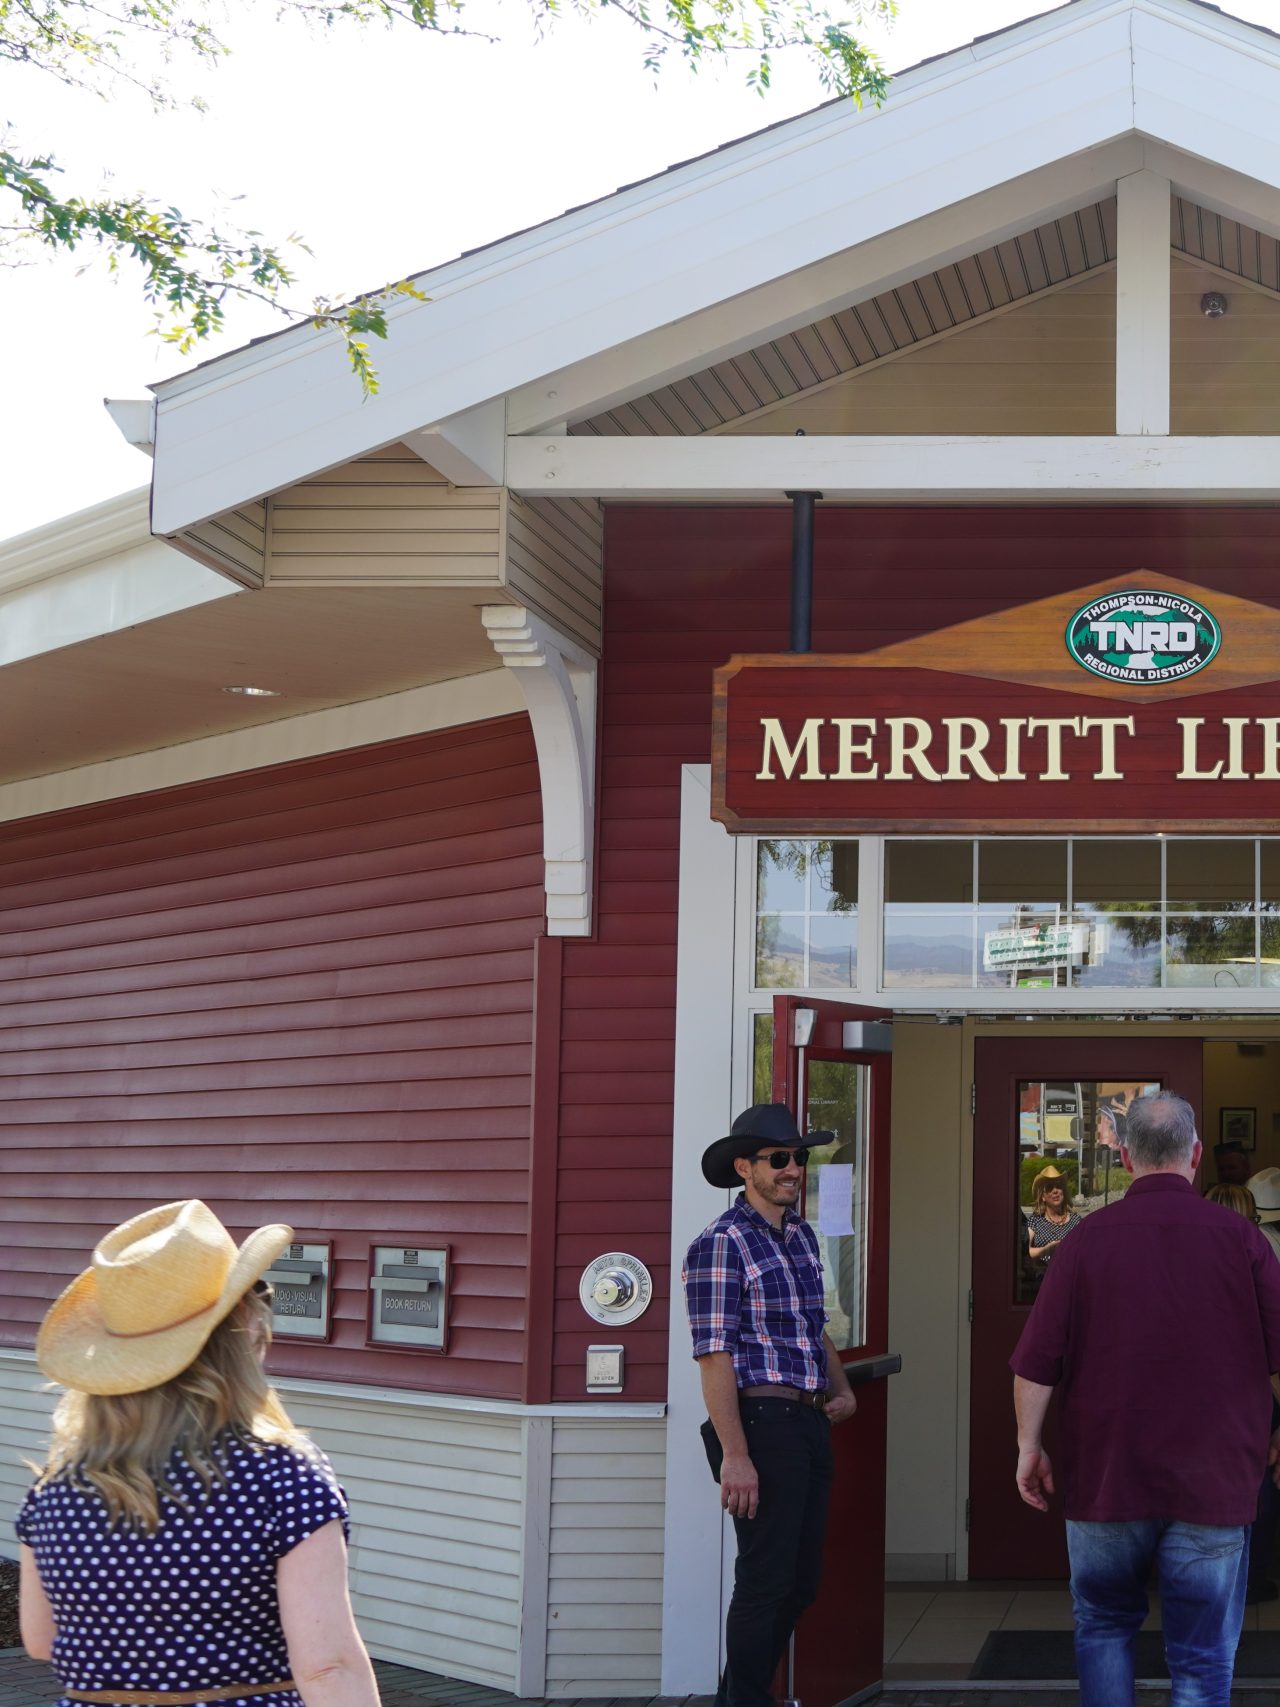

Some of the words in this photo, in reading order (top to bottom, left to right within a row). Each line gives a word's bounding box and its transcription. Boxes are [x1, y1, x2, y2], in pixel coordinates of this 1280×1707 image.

[1083, 595, 1203, 622] THOMPSON-NICOLA
[1090, 621, 1195, 651] TNRD
[1083, 653, 1145, 680] REGIONAL
[1147, 653, 1202, 680] DISTRICT
[755, 715, 1135, 782] MERRITT
[280, 1303, 306, 1315] RETURN
[385, 1298, 403, 1309] BOOK
[404, 1299, 432, 1312] RETURN
